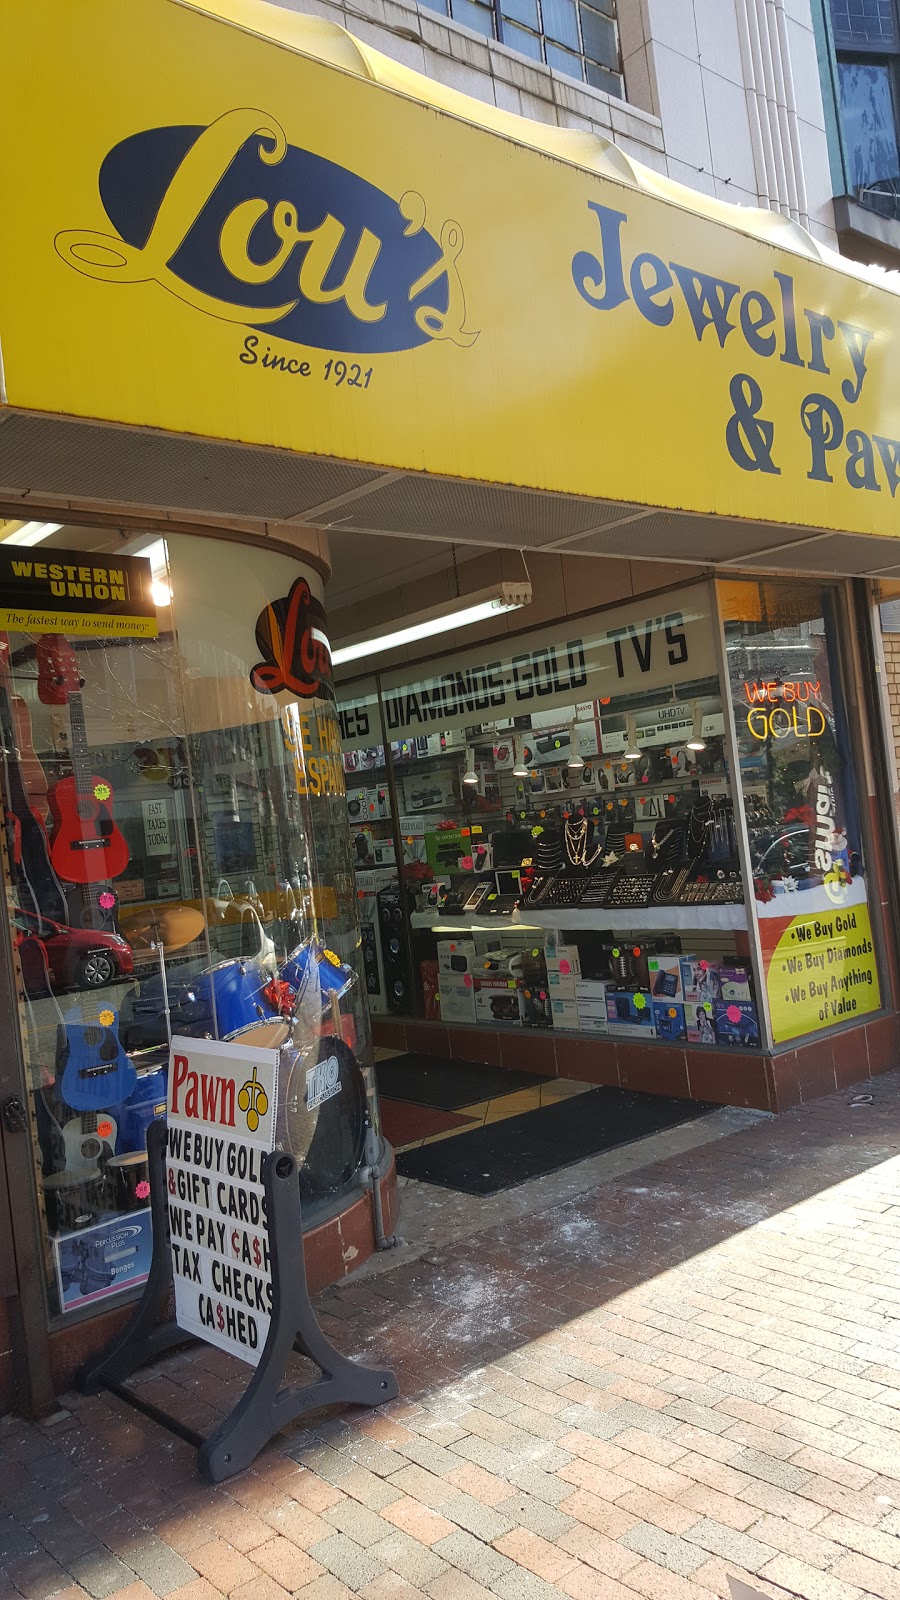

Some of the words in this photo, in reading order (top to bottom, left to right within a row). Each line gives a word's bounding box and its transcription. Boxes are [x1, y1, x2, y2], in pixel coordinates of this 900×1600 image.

[54, 107, 481, 347] Lou's
[571, 199, 874, 404] Jewelry
[239, 335, 312, 377] Since
[323, 358, 374, 389] 1921
[725, 373, 782, 476] &
[11, 560, 125, 585] WESTERN
[50, 581, 126, 601] UNION
[6, 613, 24, 624] The
[25, 614, 58, 627] fastest
[60, 618, 80, 630] way
[81, 617, 91, 628] to
[92, 618, 115, 629] send
[606, 612, 688, 678] TV'S
[744, 682, 777, 703] WE
[782, 681, 821, 702] BUY
[576, 704, 592, 712] SANYO
[747, 705, 826, 740] GOLD
[148, 802, 163, 815] FAST
[147, 818, 167, 831] TAXES
[147, 833, 169, 846] TODAY
[796, 925, 811, 942] We
[814, 921, 833, 938] Buy
[835, 913, 857, 932] Gold
[786, 956, 803, 974] We
[805, 952, 825, 970] Buy
[826, 938, 872, 963] Diamonds
[790, 985, 806, 1003] We
[808, 981, 828, 998] Buy
[830, 968, 873, 992] Anything
[819, 1002, 829, 1021] of
[831, 997, 857, 1017] Value
[171, 1054, 236, 1128] Pawn
[306, 1055, 339, 1100] TKO
[95, 1231, 129, 1248] PERCUSSION
[169, 1204, 193, 1241] WE
[196, 1213, 226, 1255] PAY
[111, 1240, 126, 1250] PLUS
[110, 1261, 135, 1276] Bongos
[172, 1243, 202, 1284] TAX
[212, 1260, 273, 1316] CHECKS
